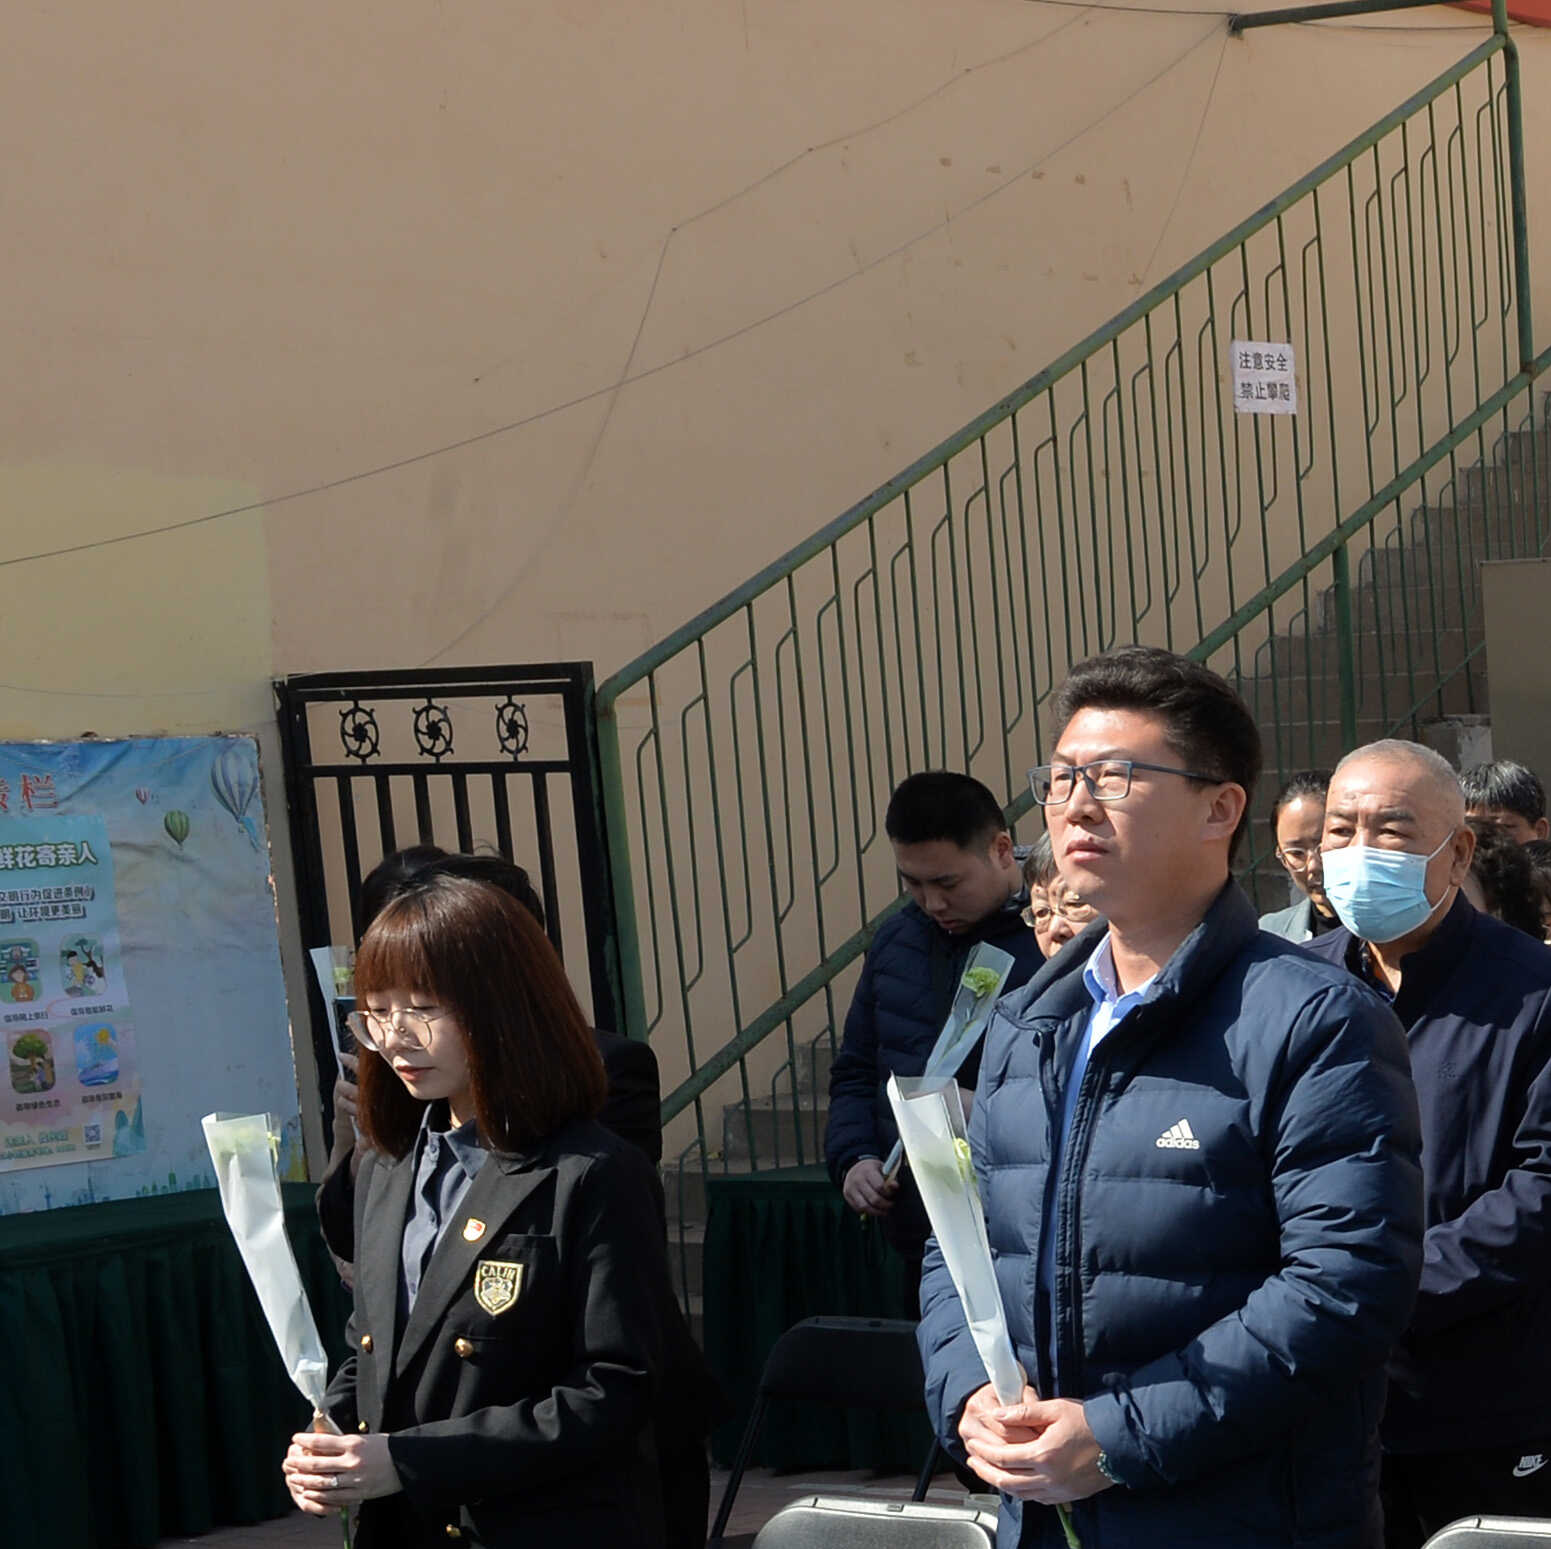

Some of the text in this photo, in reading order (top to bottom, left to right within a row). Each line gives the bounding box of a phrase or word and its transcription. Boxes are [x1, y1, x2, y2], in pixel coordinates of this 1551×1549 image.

[1239, 351, 1288, 372] 注意安全
[1156, 1137, 1200, 1150] adidas
[1519, 1454, 1543, 1469] NIKE
